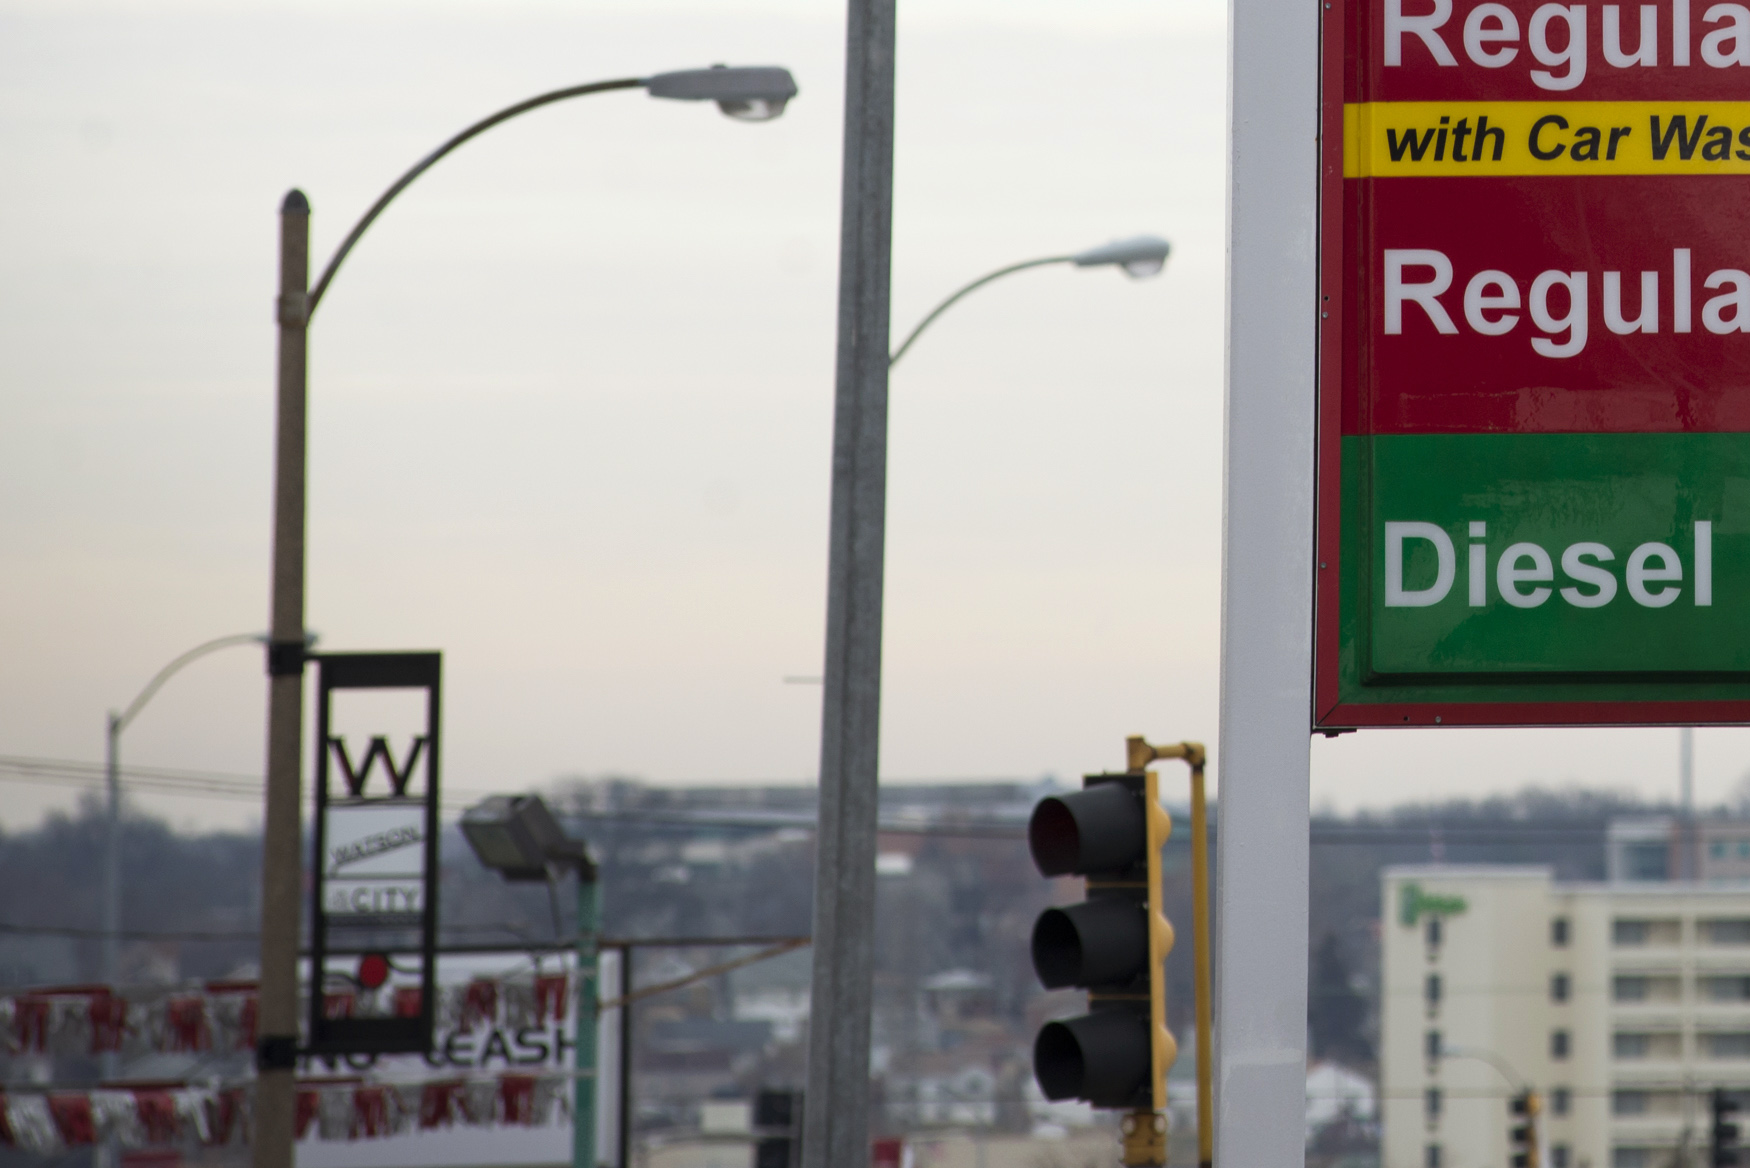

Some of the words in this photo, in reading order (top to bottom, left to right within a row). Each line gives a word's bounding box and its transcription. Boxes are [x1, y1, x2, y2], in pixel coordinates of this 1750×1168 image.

[1387, 116, 1505, 162] with
[1528, 115, 1631, 161] Car
[1386, 521, 1711, 607] Diesel
